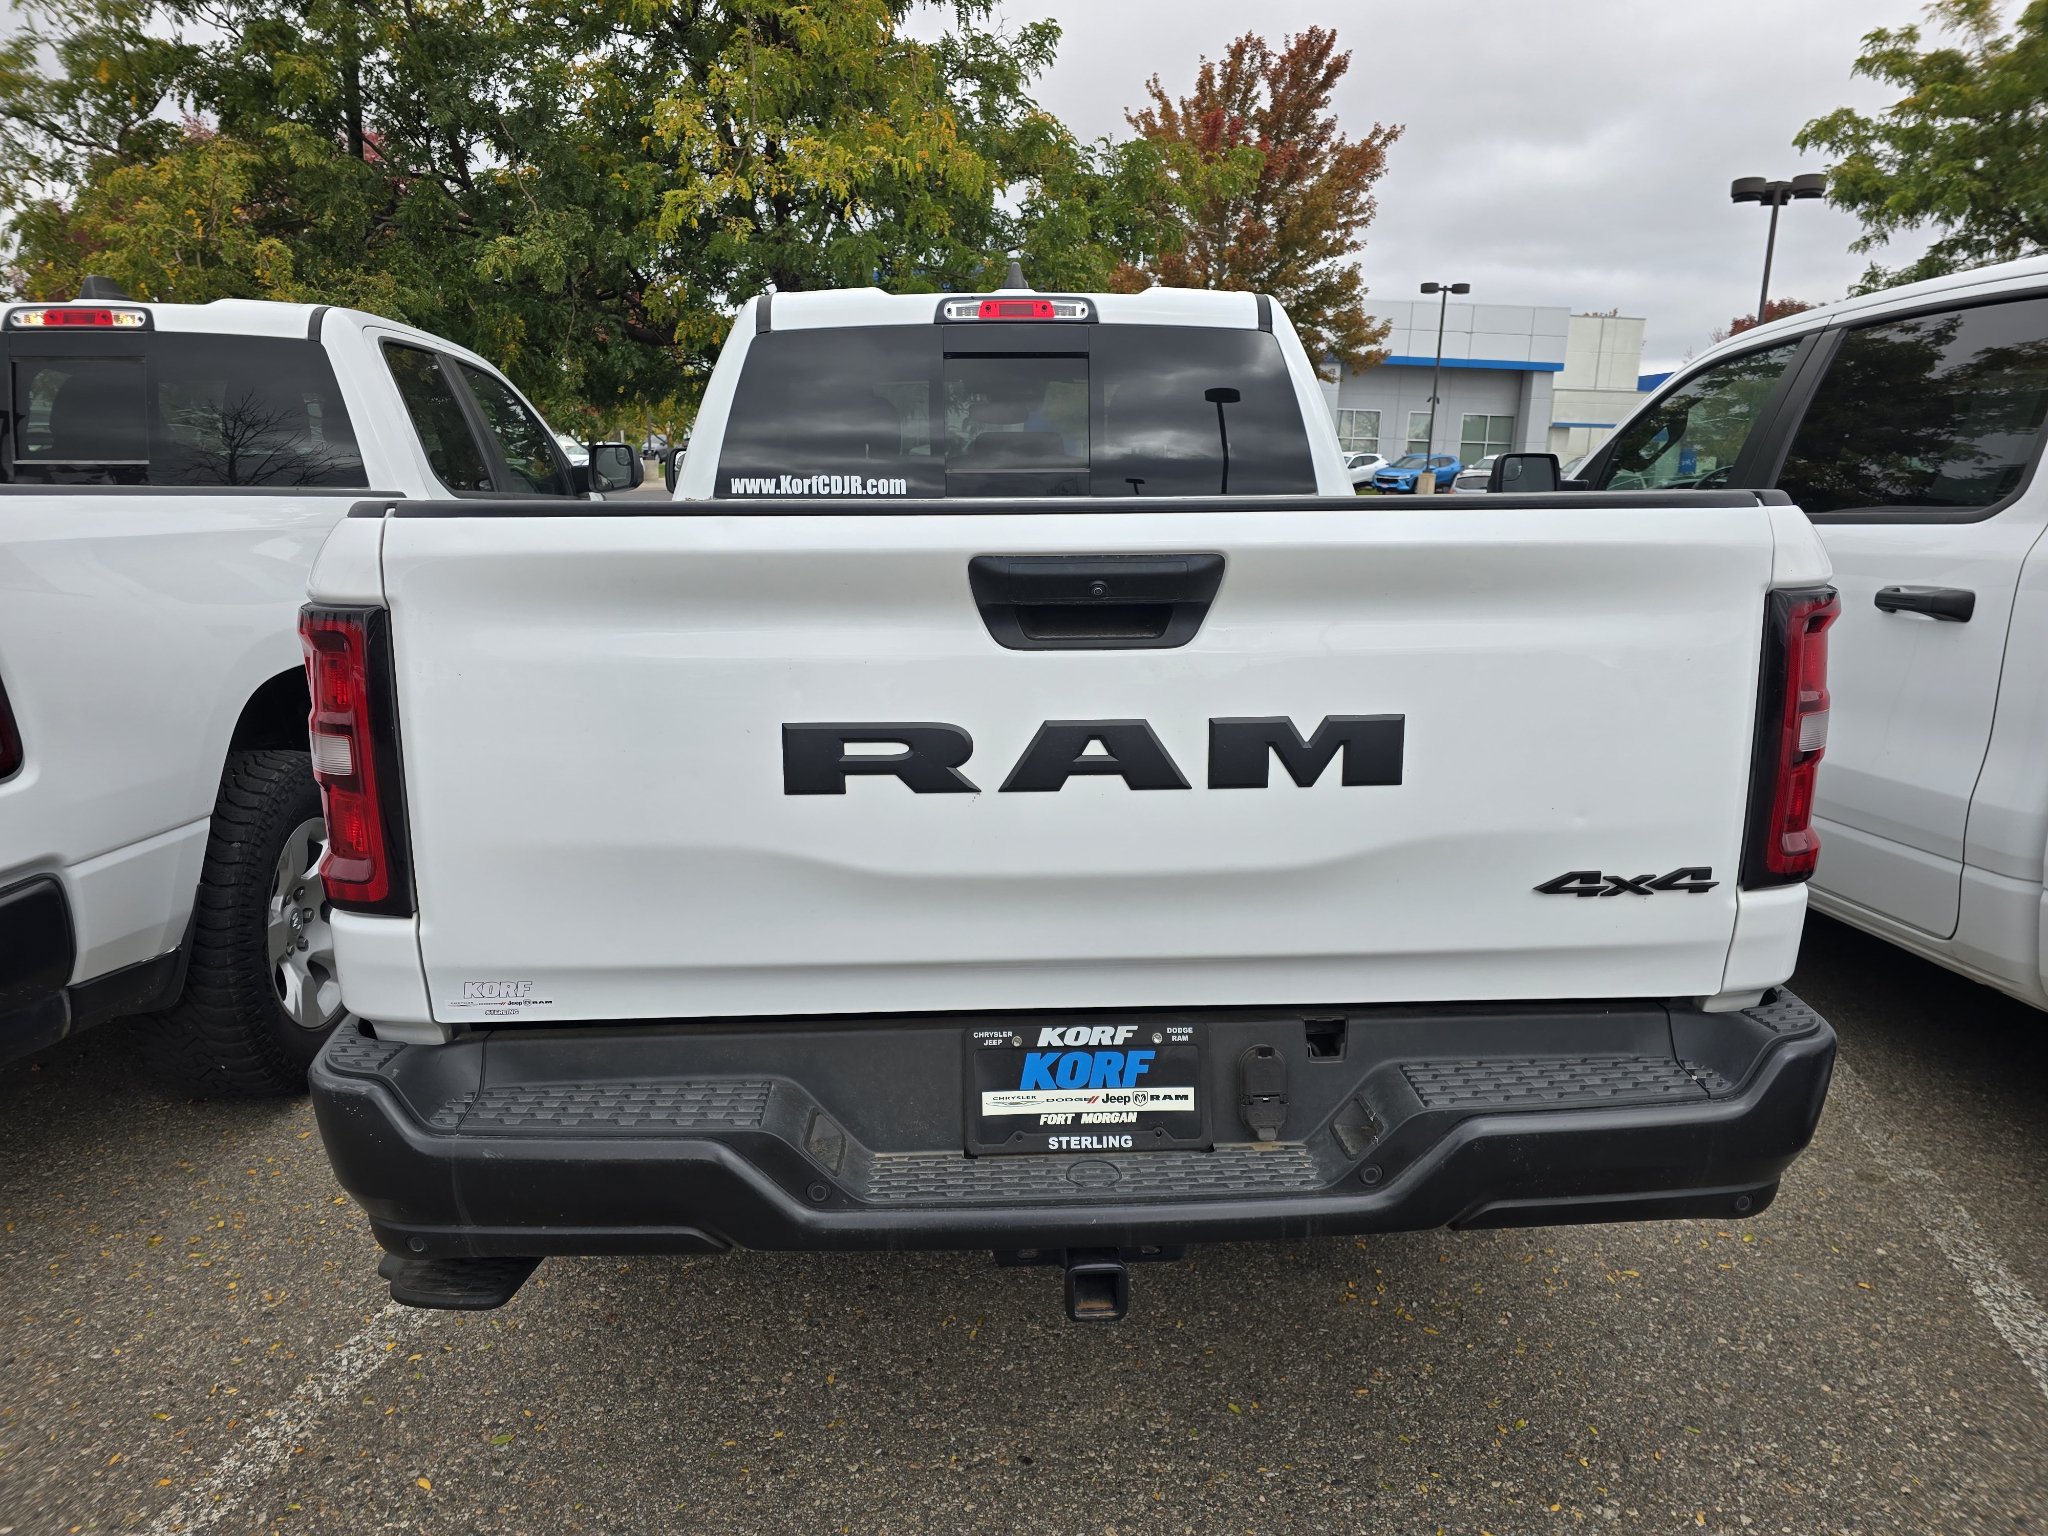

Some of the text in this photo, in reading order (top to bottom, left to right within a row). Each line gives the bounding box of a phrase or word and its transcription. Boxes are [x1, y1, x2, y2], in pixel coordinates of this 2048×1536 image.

[730, 475, 907, 495] www.KorfCDJR.com
[782, 714, 1405, 795] RAM
[1532, 866, 1720, 897] 4x4
[463, 981, 533, 999] KORF
[973, 1031, 1013, 1039] CHRYSLER
[1037, 1025, 1139, 1047] KORF
[1019, 1050, 1156, 1090] KORF
[1101, 1093, 1131, 1106] Jeep
[1039, 1112, 1138, 1126] FORT MORGAN
[1048, 1135, 1133, 1150] STERLING
